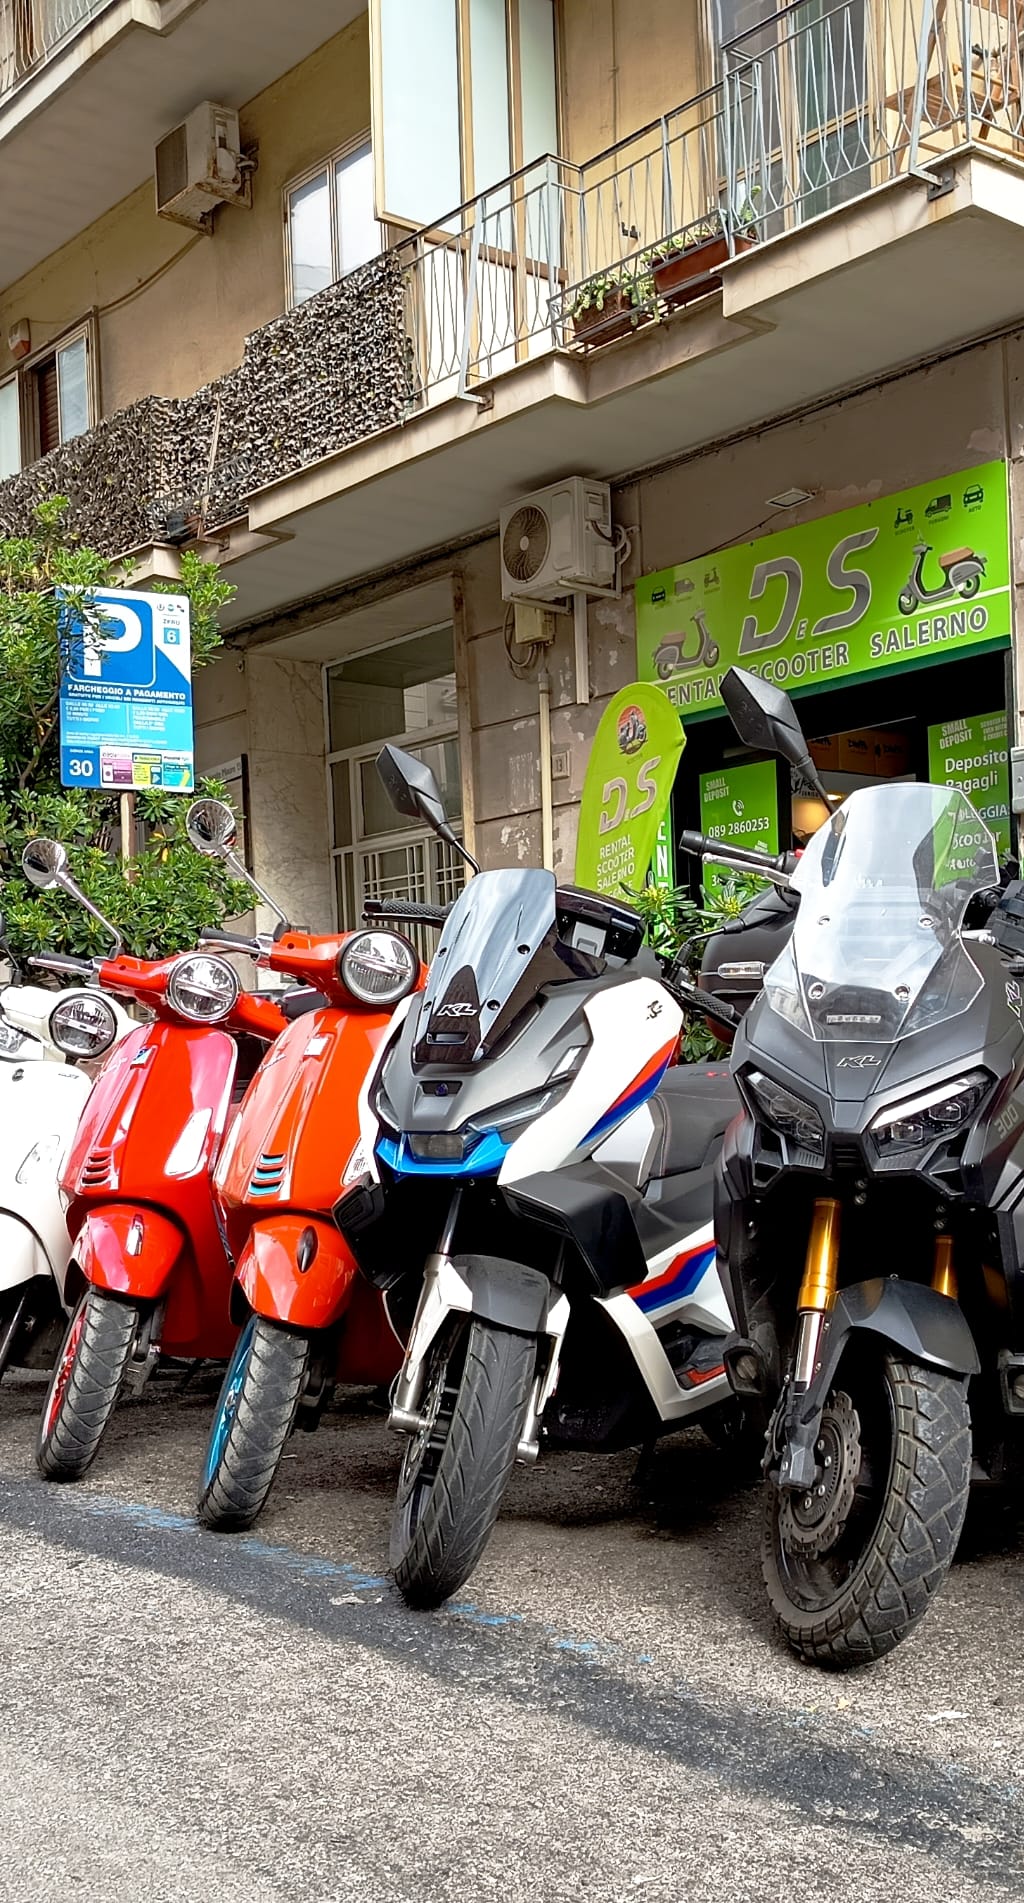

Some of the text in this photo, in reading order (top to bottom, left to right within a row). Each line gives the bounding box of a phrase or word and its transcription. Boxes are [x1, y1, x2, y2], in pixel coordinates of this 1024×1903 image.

[666, 605, 988, 706] ENTA SCOOTER SALERNO
[939, 728, 973, 750] DEPOSIT
[942, 719, 968, 737] SMALL
[69, 759, 93, 777] 30
[945, 750, 1008, 774] Deposito
[704, 786, 730, 802] DEPOSIT
[705, 777, 726, 791] SMALL
[708, 816, 770, 838] 089 2860253
[600, 834, 631, 859] RENTAL
[596, 847, 635, 876] SCOOTER
